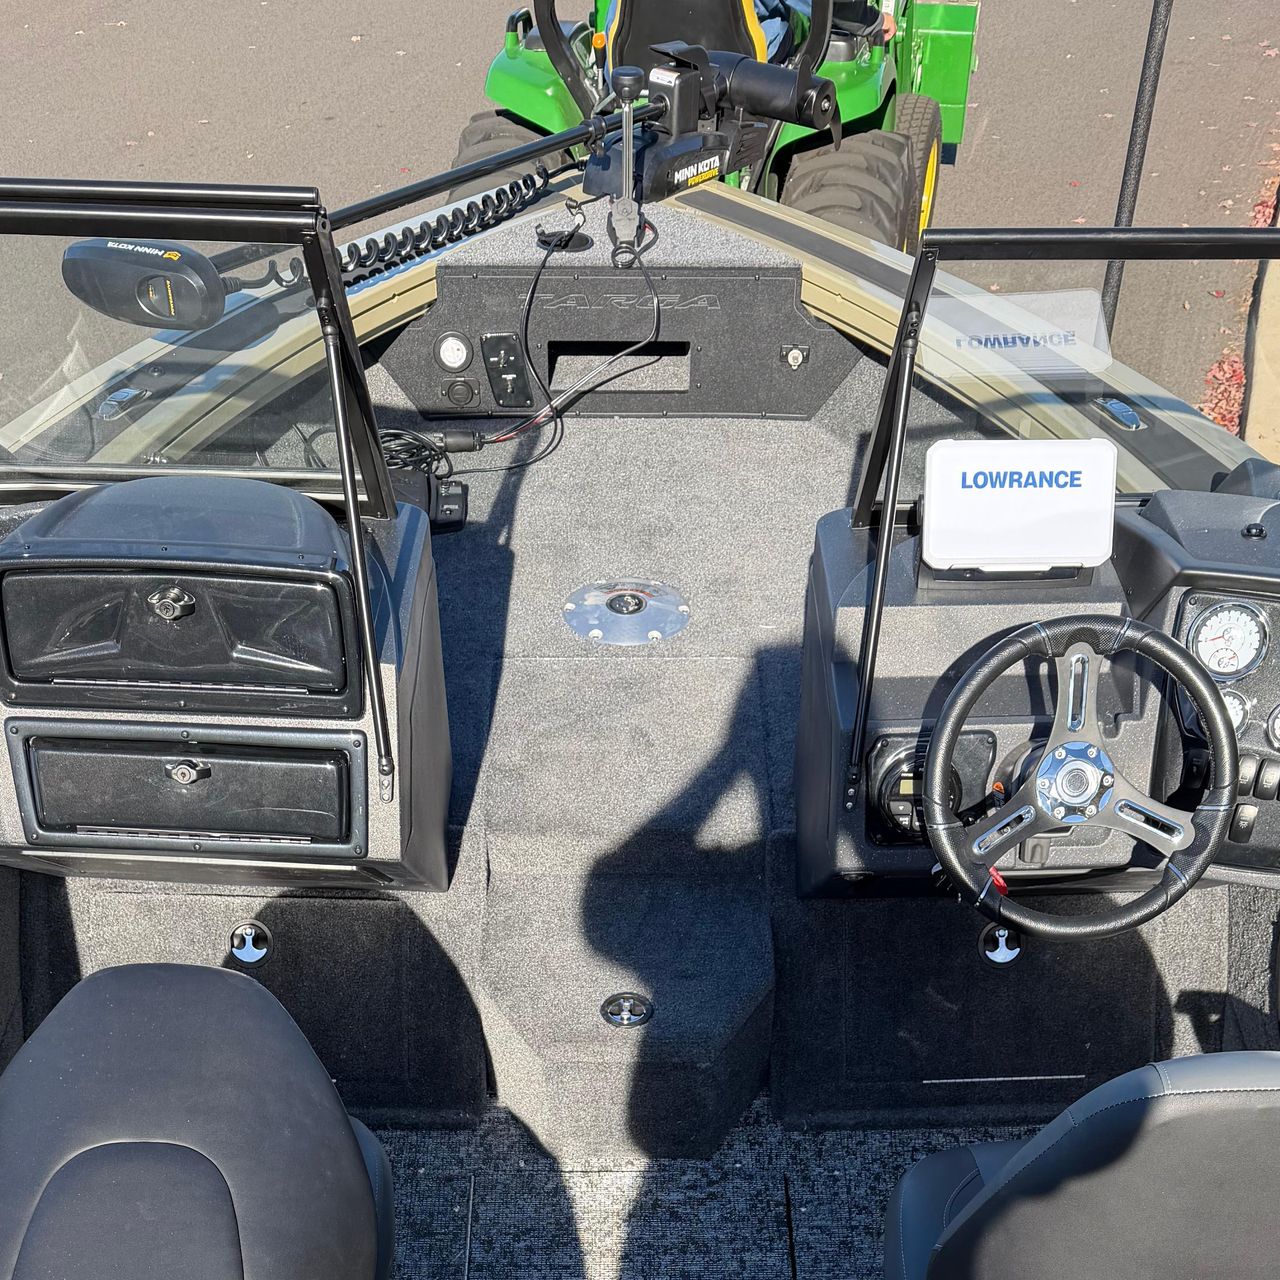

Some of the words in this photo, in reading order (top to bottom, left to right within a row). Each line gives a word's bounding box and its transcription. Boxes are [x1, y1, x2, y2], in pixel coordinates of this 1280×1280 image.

[674, 163, 697, 185] MINN
[698, 155, 720, 174] KOTA
[107, 241, 135, 251] KOTA
[135, 246, 164, 256] MINN
[518, 294, 721, 310] TARGA
[961, 470, 1083, 489] LOWRANCE
